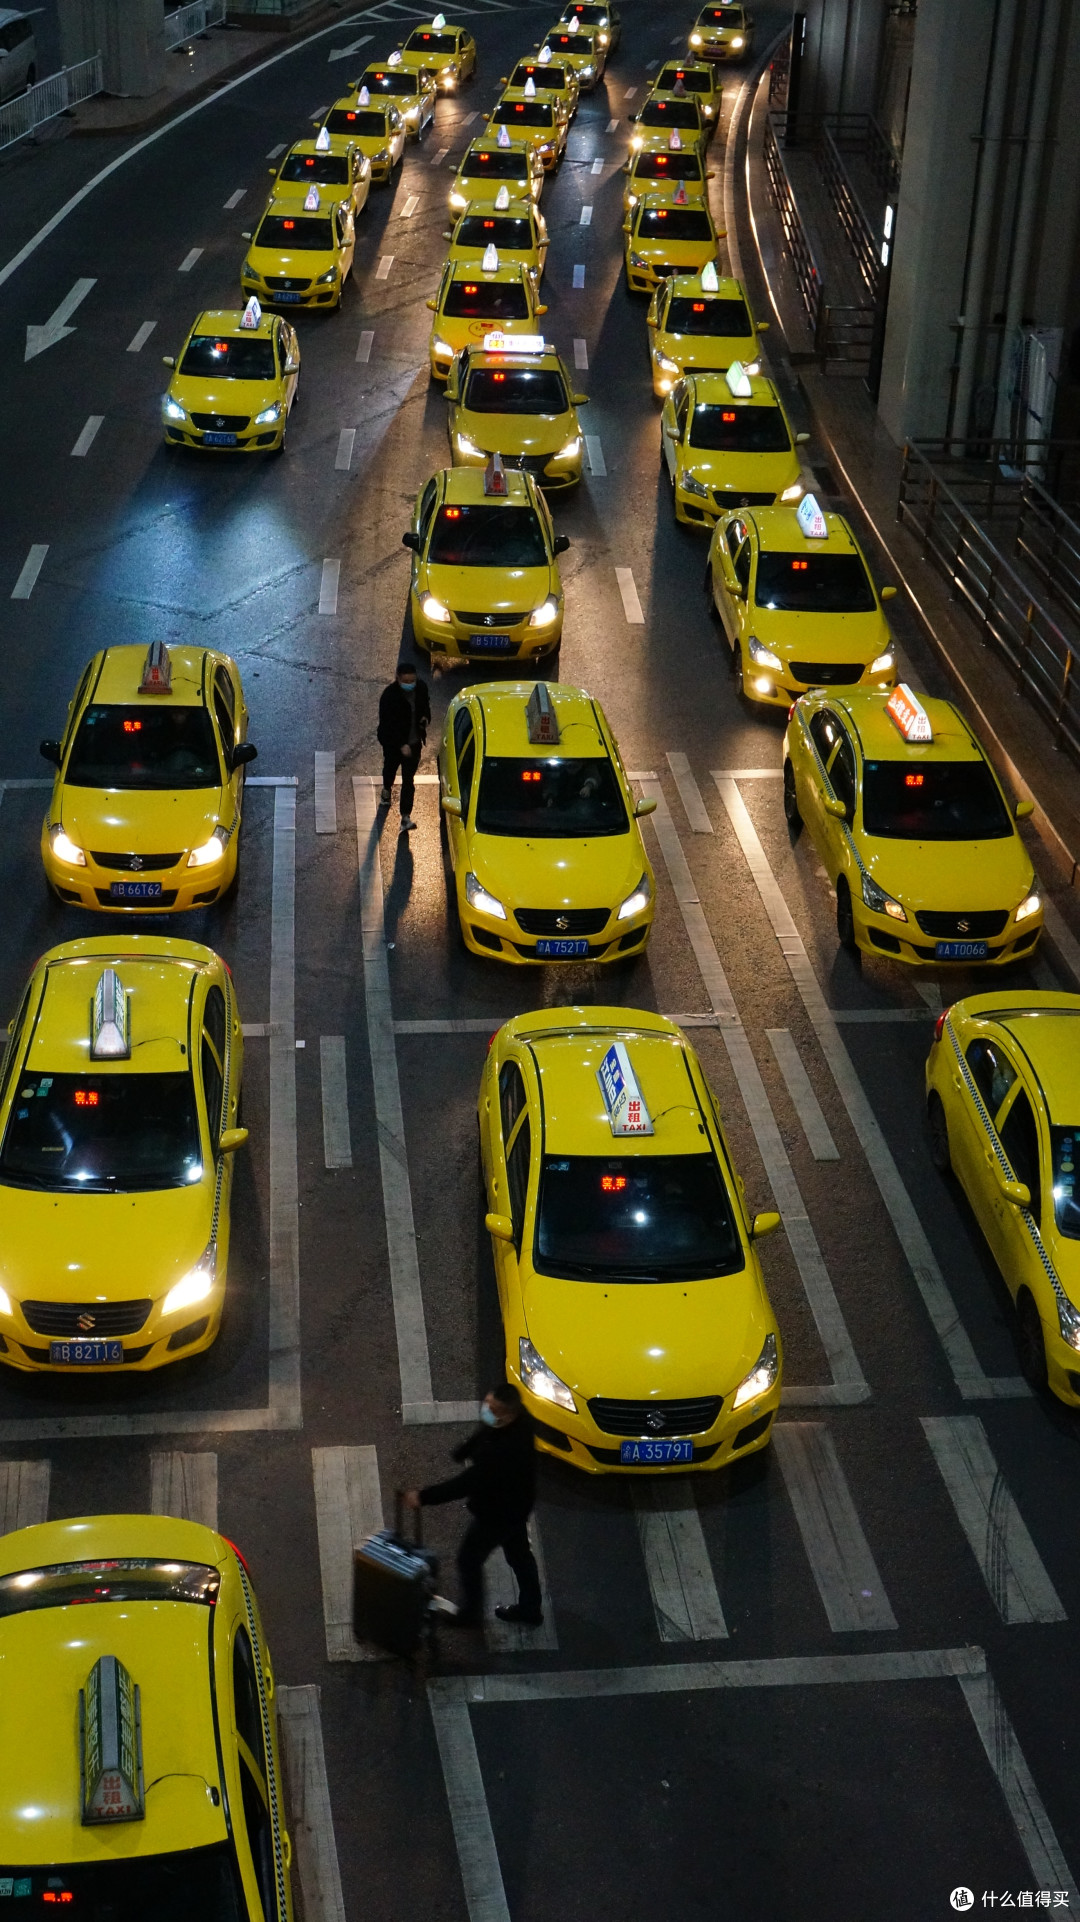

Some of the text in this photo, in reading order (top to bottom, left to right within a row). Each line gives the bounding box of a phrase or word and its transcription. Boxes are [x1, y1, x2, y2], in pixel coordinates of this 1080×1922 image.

[471, 636, 509, 647] B57T79
[918, 716, 926, 733] 出租
[628, 1100, 641, 1123] 出租
[103, 1776, 122, 1804] 出租
[96, 1805, 131, 1815] TAXI
